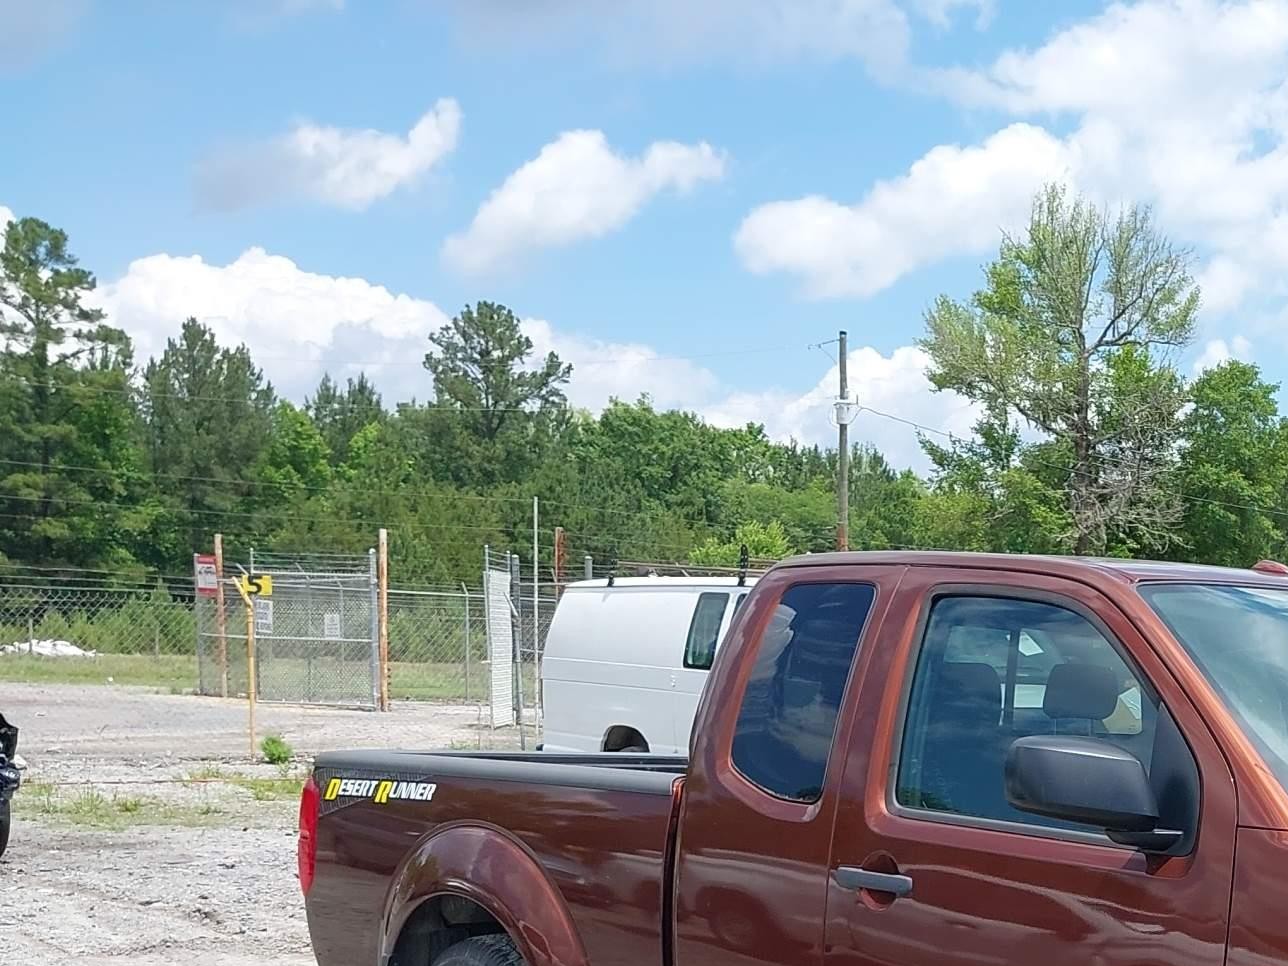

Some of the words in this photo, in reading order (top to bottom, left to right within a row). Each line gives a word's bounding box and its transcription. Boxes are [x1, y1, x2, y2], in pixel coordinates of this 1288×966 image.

[247, 575, 262, 595] 5
[324, 778, 378, 800] DESERT
[374, 780, 437, 803] RUNNER
